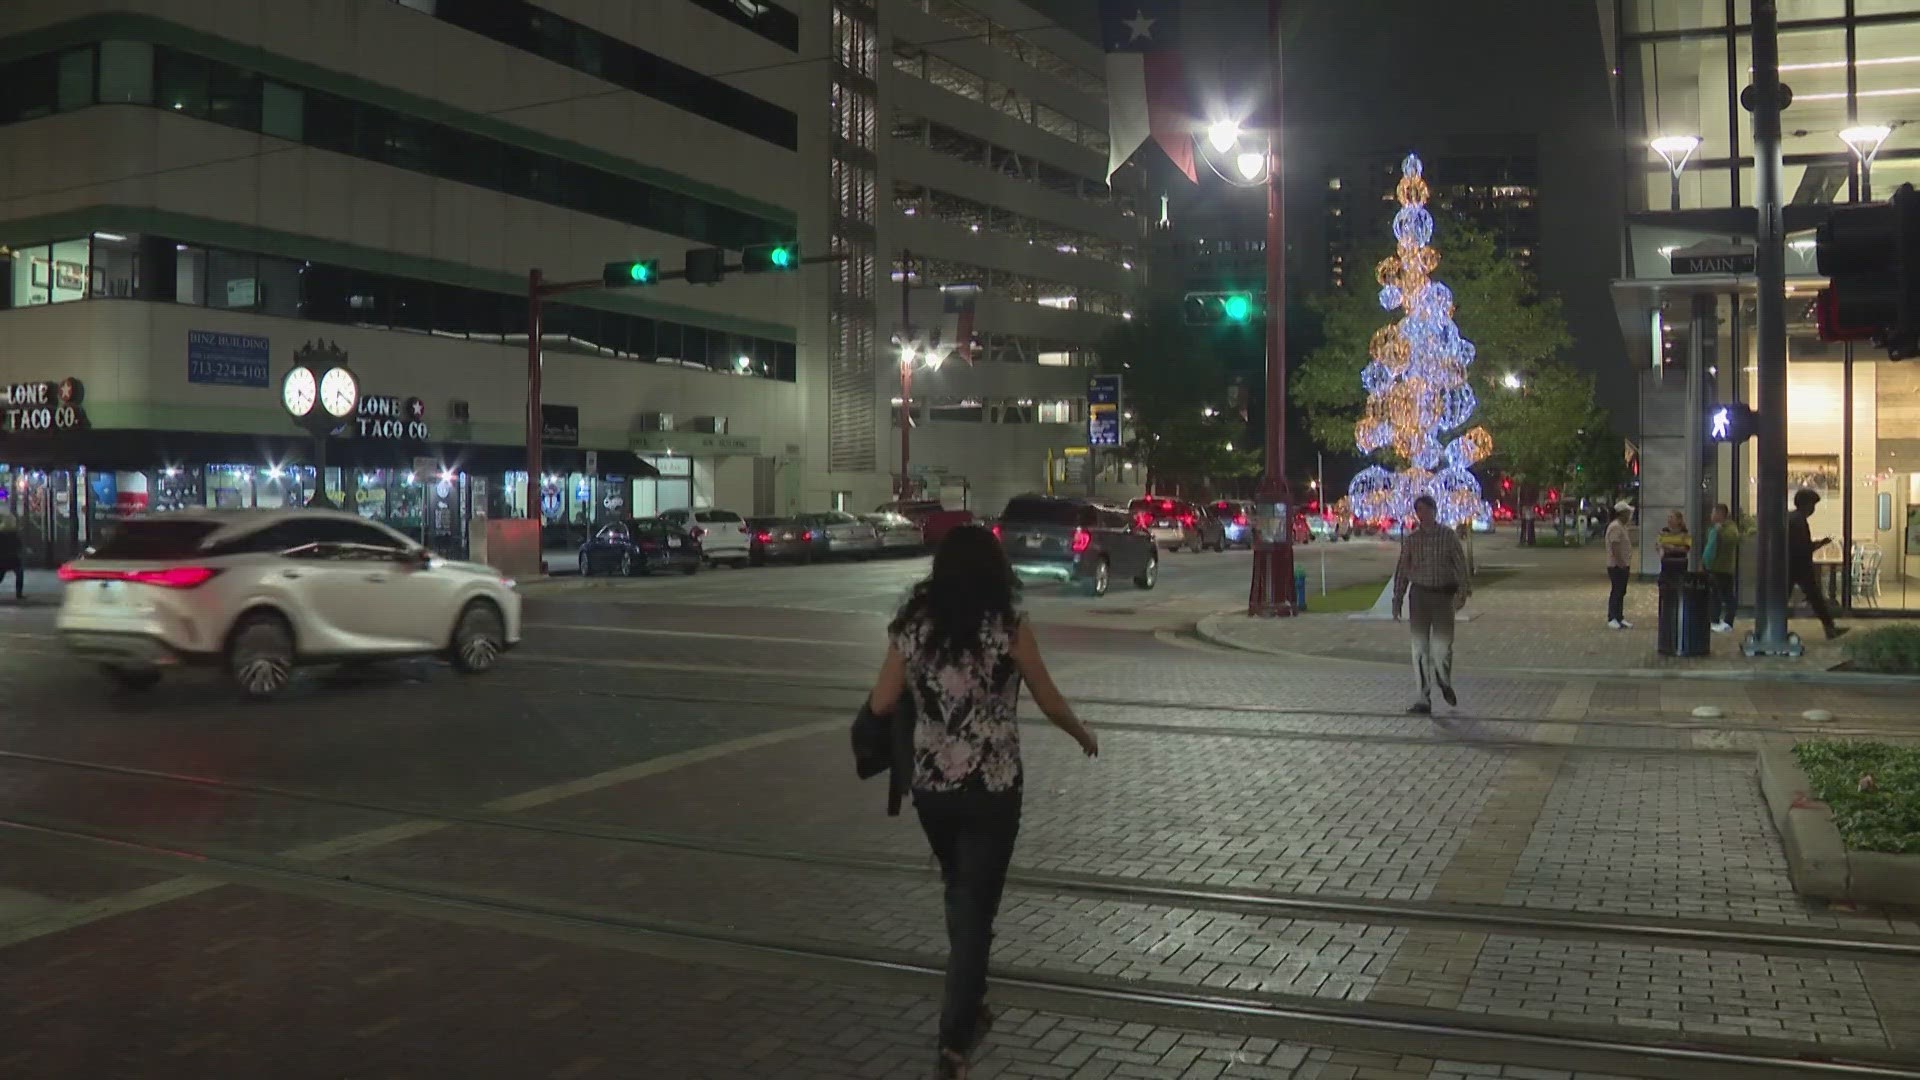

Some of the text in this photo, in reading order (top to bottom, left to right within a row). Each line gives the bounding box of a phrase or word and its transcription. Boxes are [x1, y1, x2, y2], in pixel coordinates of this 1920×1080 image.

[1689, 257, 1734, 272] MAIN
[190, 332, 268, 351] BINZ BUILDING
[191, 360, 267, 380] 713-224-4103
[7, 383, 49, 405] LONE
[357, 396, 401, 417] LONE
[7, 406, 79, 430] TACO CO.
[355, 416, 432, 440] TACO CO.
